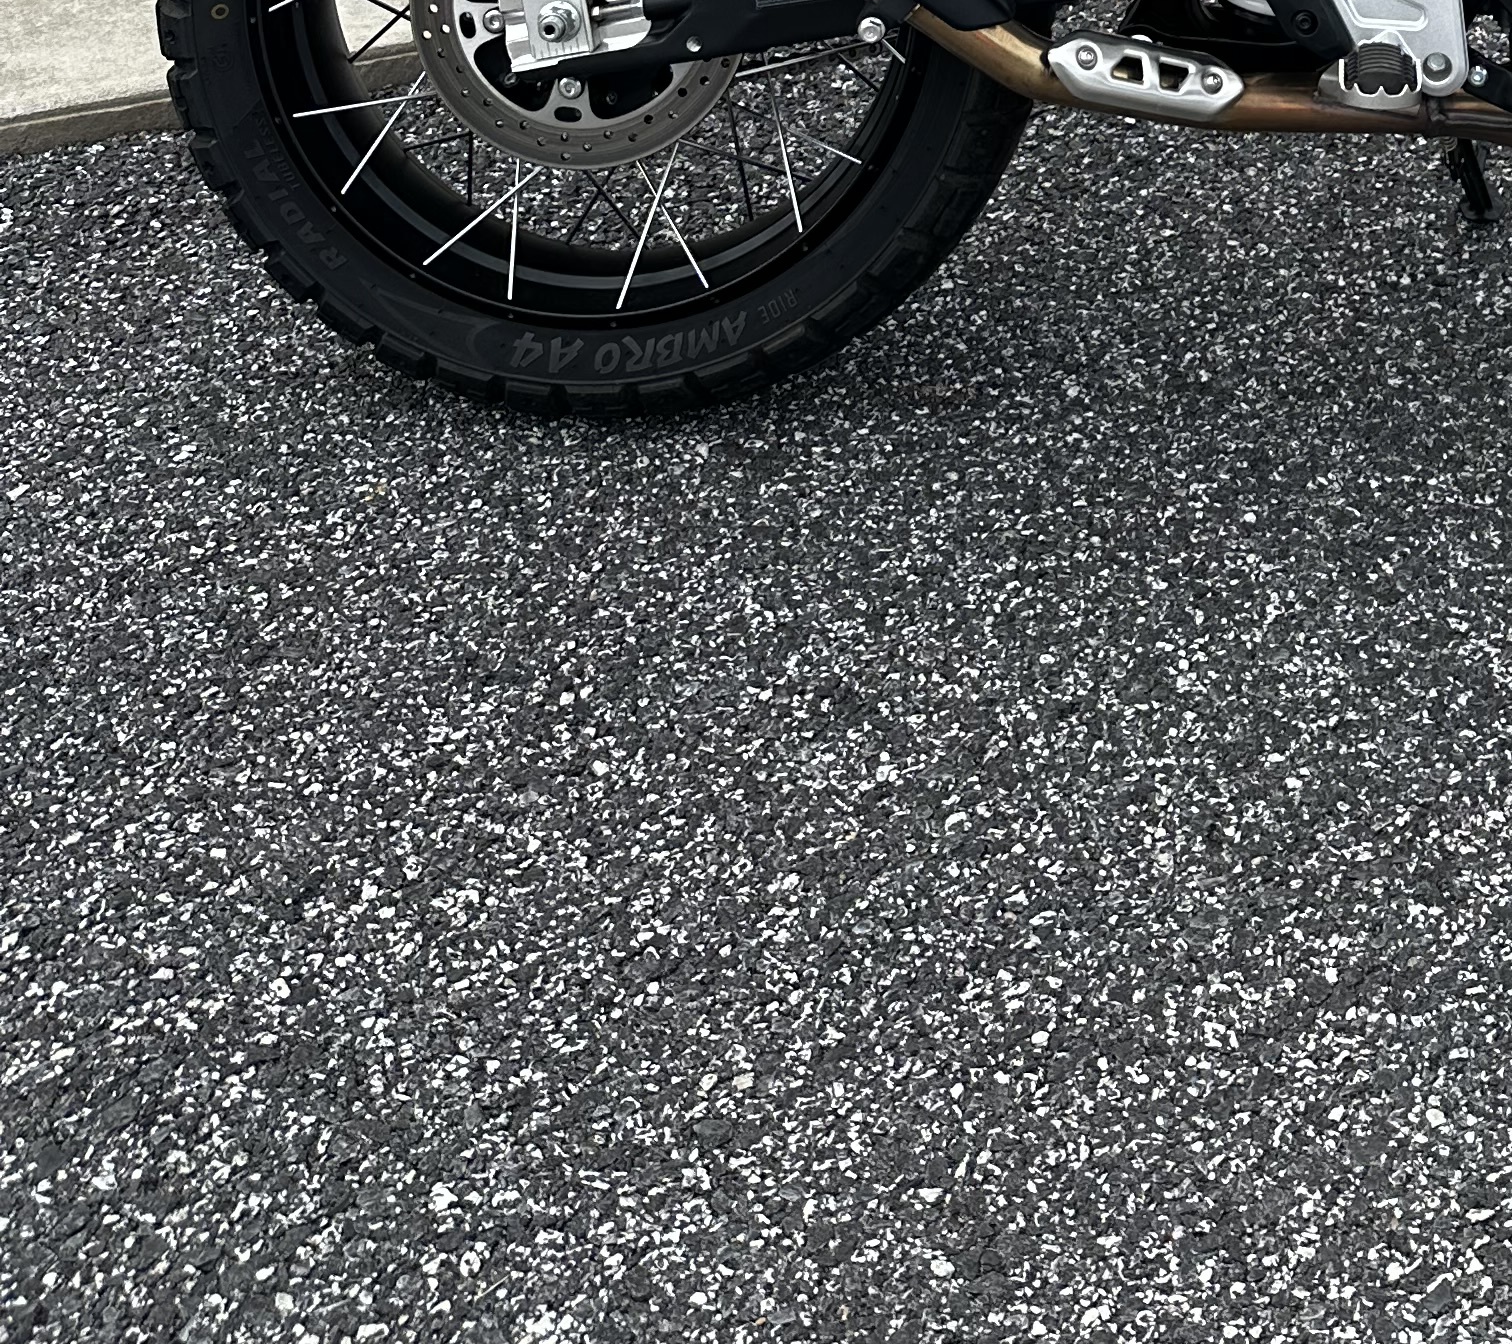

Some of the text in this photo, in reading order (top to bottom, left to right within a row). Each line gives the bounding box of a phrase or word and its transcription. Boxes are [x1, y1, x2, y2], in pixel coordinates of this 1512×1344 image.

[243, 138, 350, 272] RADIAL
[510, 287, 798, 373] RIDE AMBRO A4
